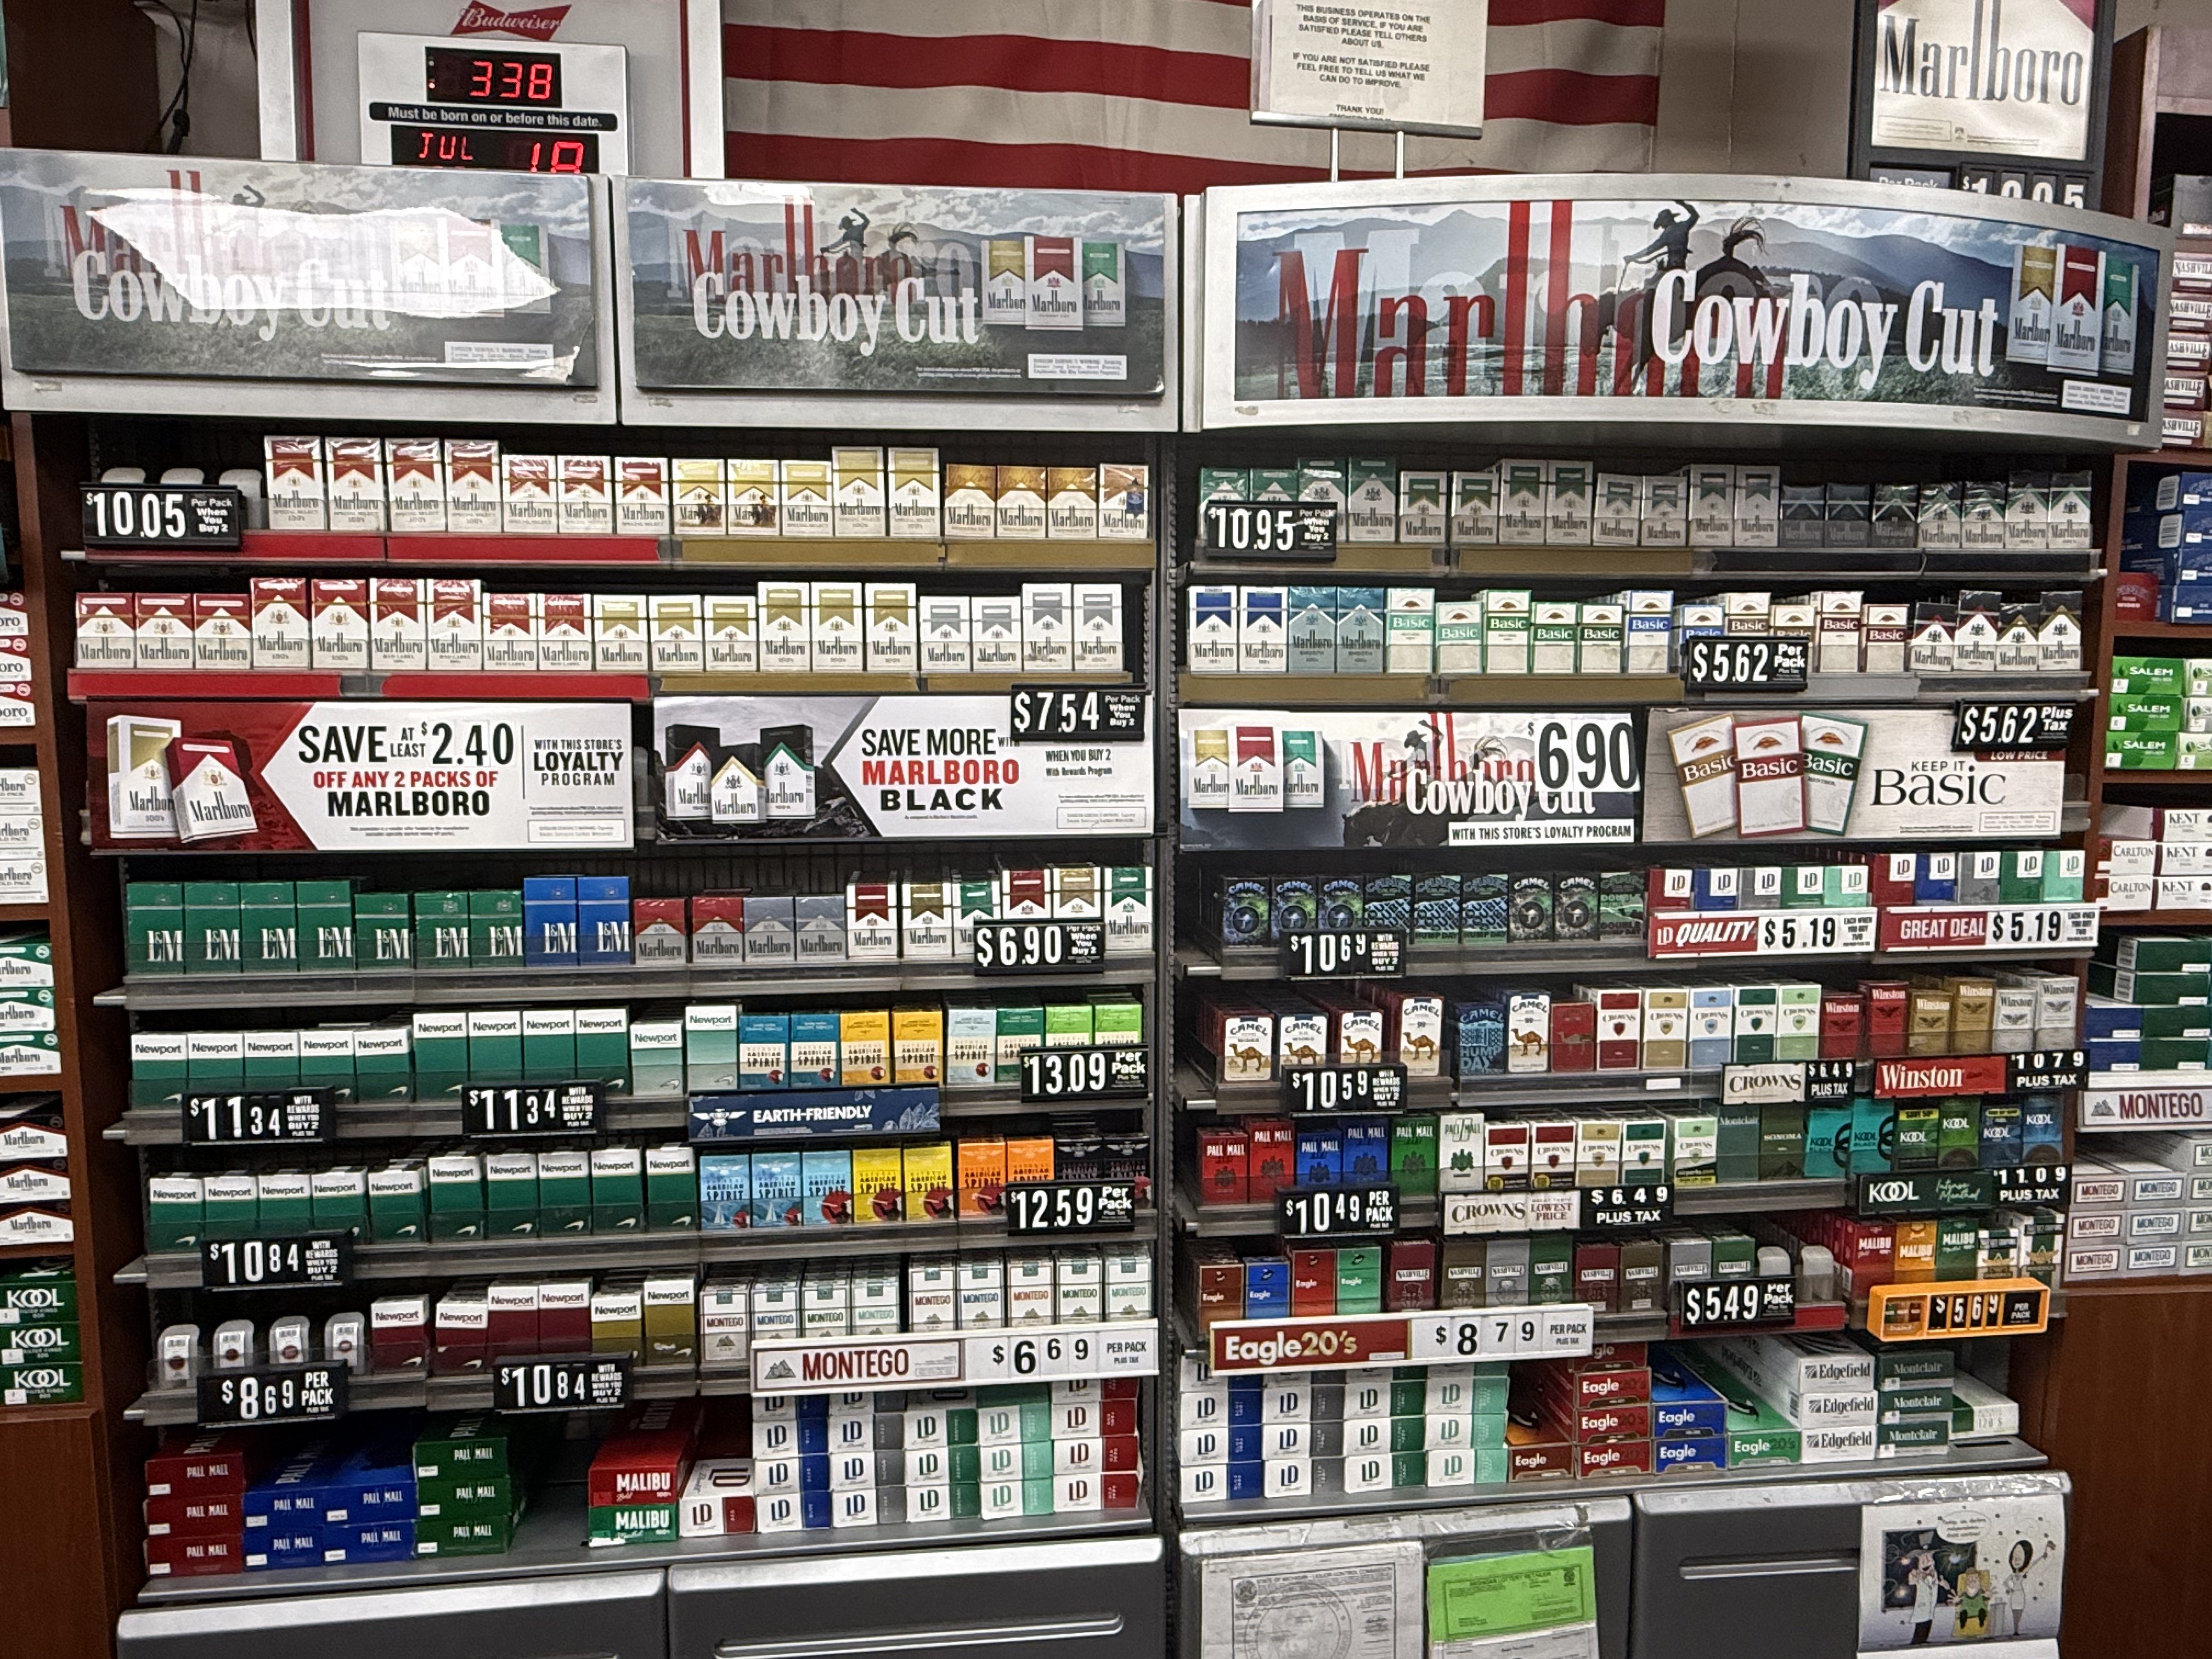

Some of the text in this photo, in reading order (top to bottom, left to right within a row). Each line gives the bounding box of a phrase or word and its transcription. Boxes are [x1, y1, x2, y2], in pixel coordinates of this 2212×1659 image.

[461, 7, 560, 30] Budweiser
[1296, 4, 1313, 12] THIS
[1316, 6, 1356, 16] BUSINESS
[1358, 10, 1400, 20] OPERATES
[1416, 15, 1430, 24] THE
[1303, 15, 1327, 23] BASIS
[1389, 22, 1406, 31] YOU
[1407, 24, 1423, 32] ARE
[1299, 24, 1427, 42] SATISFIED PLEASE TELL OTHERS
[1342, 38, 1369, 47] ABOUT
[1880, 0, 2083, 105] Marlboro
[1302, 53, 1319, 61] YOU
[1358, 58, 1397, 69] SATISFIED
[1400, 62, 1430, 72] PLEASE
[1297, 63, 1317, 71] FEEL
[1319, 64, 1339, 73] FREE
[1355, 67, 1373, 76] TELL
[1389, 71, 1410, 80] WHAT
[388, 106, 602, 127] Must be born on or before this date.
[1336, 104, 1363, 114] THANK
[1031, 287, 1076, 313] Marlboro
[693, 270, 980, 357] Cowboy Cut
[1652, 270, 1997, 391] Cowboy Cut
[947, 504, 990, 525] Marlboro
[1392, 615, 1429, 628] Basic
[80, 637, 131, 659] Marlboro
[2130, 667, 2172, 676] SALEM
[2041, 707, 2073, 720] Plus
[1110, 719, 1126, 727] Buy
[2044, 719, 2067, 732] Tax
[400, 727, 414, 742] AT
[862, 729, 994, 756] SAVE MORE
[300, 725, 387, 765] SAVE
[391, 742, 426, 758] LEAST
[534, 739, 622, 751] WITH THIS STORE'S
[534, 752, 623, 772] LOYALTY
[1046, 749, 1111, 762] WHEN YOU BUY 2
[1991, 751, 2047, 760] LOW PRICE
[862, 760, 1019, 786] MARLBORO
[1062, 767, 1086, 776] Rewards
[1088, 767, 1112, 777] Program
[1742, 758, 1797, 779] Basic
[1912, 760, 1965, 772] KEEP IT
[313, 771, 498, 788] OFF ANY 2 PACKS OF
[541, 773, 616, 786] PROGRAM
[1872, 766, 2006, 806] Basic
[328, 791, 490, 816] MARLBORO
[881, 789, 1003, 811] BLACK
[1404, 769, 1533, 822] Cowboy
[190, 792, 251, 823] Marlboro
[2169, 813, 2200, 824] KENT
[1452, 825, 1632, 841] WITH THIS STORE'S LOYALTY PROGRAM
[2113, 846, 2153, 857] CARLTON
[1675, 922, 1754, 947] QUALITY
[1901, 917, 1985, 939] GREAT DEAL
[1403, 1003, 1440, 1017] CAMEL
[417, 1022, 462, 1034] Newport
[1729, 1073, 1802, 1093] CROWNS
[1882, 1063, 1963, 1090] Winston
[2120, 1093, 2202, 1119] MONTEGO
[753, 1105, 872, 1125] EARTH-FRIENDLY
[1869, 1182, 1919, 1202] KOOL
[2081, 1184, 2118, 1197] MONTEGO
[1531, 1203, 1572, 1212] LOWEST
[1536, 1210, 1567, 1221] PRICE
[7, 1289, 64, 1308] KOOL
[490, 1294, 534, 1307] Newport
[1107, 1342, 1147, 1354] PER PACK
[803, 1348, 909, 1380] MONTEGO
[1819, 1364, 1870, 1379] Edgefield
[304, 1371, 329, 1388] PER
[302, 1387, 334, 1406] PACK
[1893, 1395, 1942, 1409] Montclair
[1658, 1410, 1695, 1424] Eagle
[187, 1464, 229, 1478] PALL MALL
[616, 1473, 670, 1494] MALIBU
